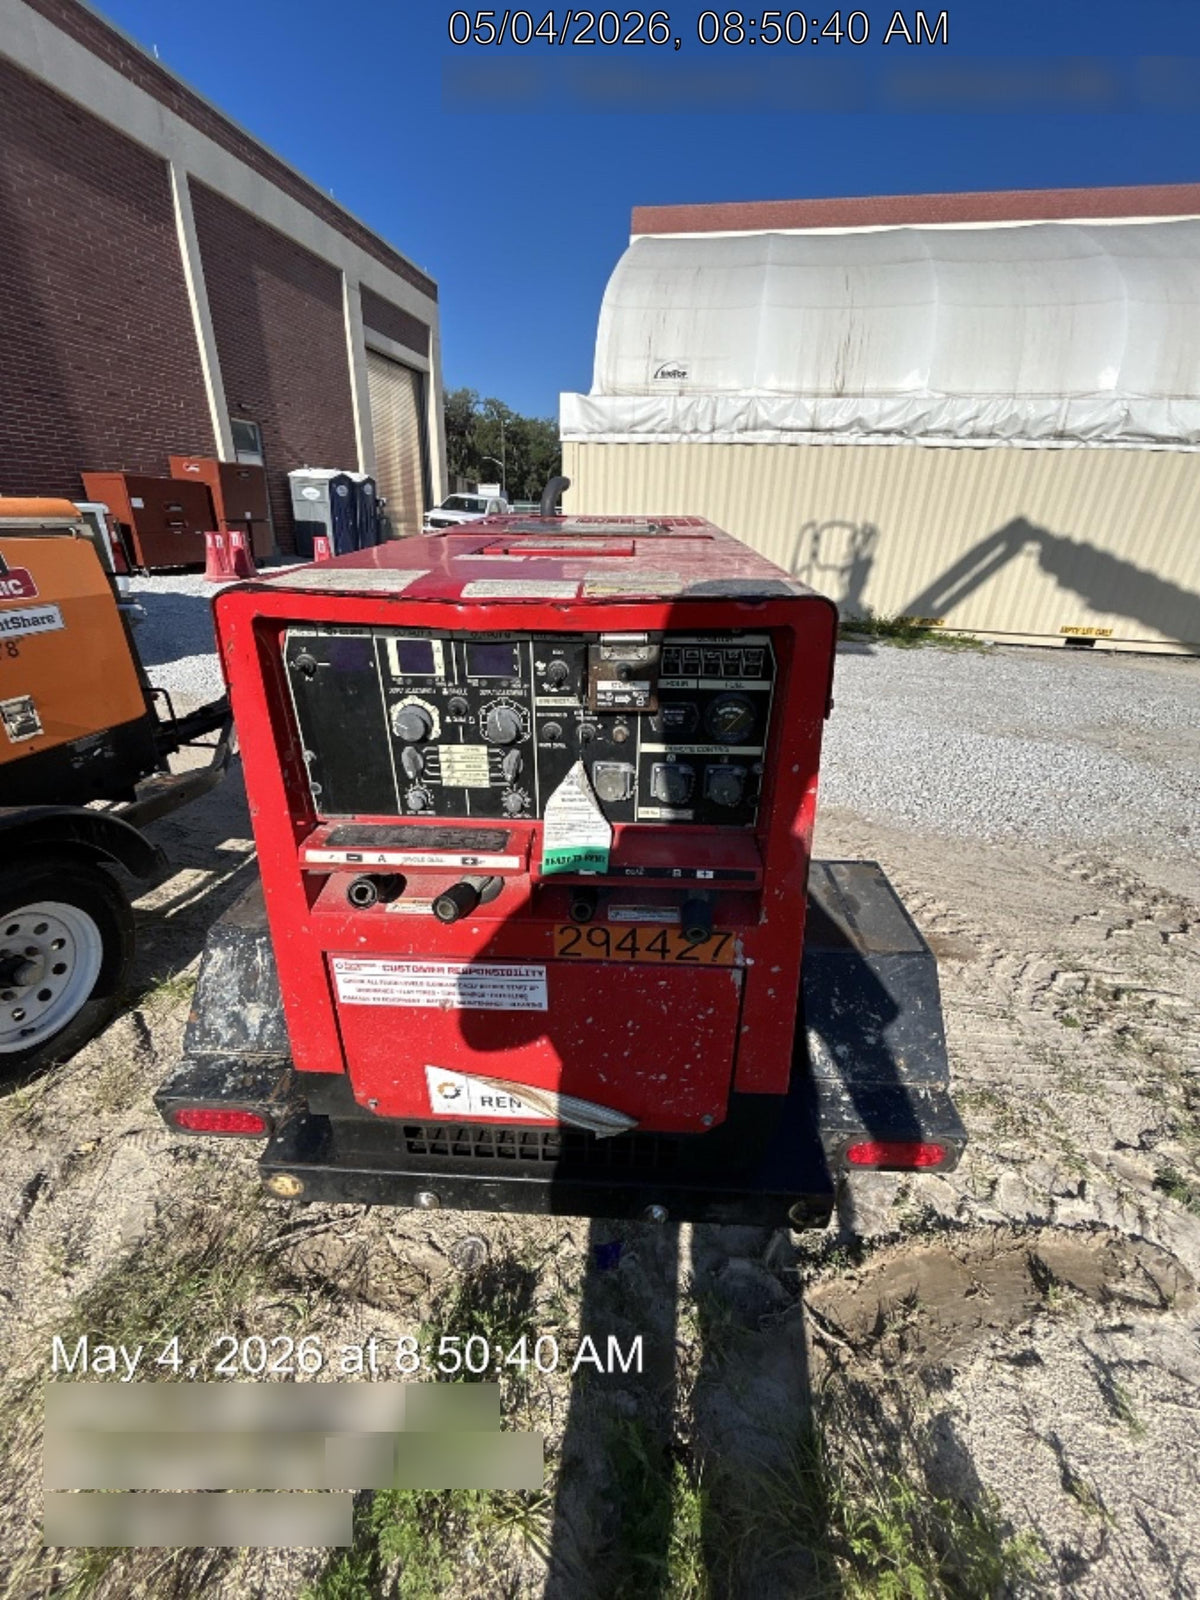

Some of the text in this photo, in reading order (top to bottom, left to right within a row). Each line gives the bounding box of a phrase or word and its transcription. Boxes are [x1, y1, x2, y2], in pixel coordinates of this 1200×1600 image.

[557, 925, 733, 962] 294427
[382, 964, 445, 975] CUSTOMER
[447, 966, 545, 978] RESPONSIBILITY
